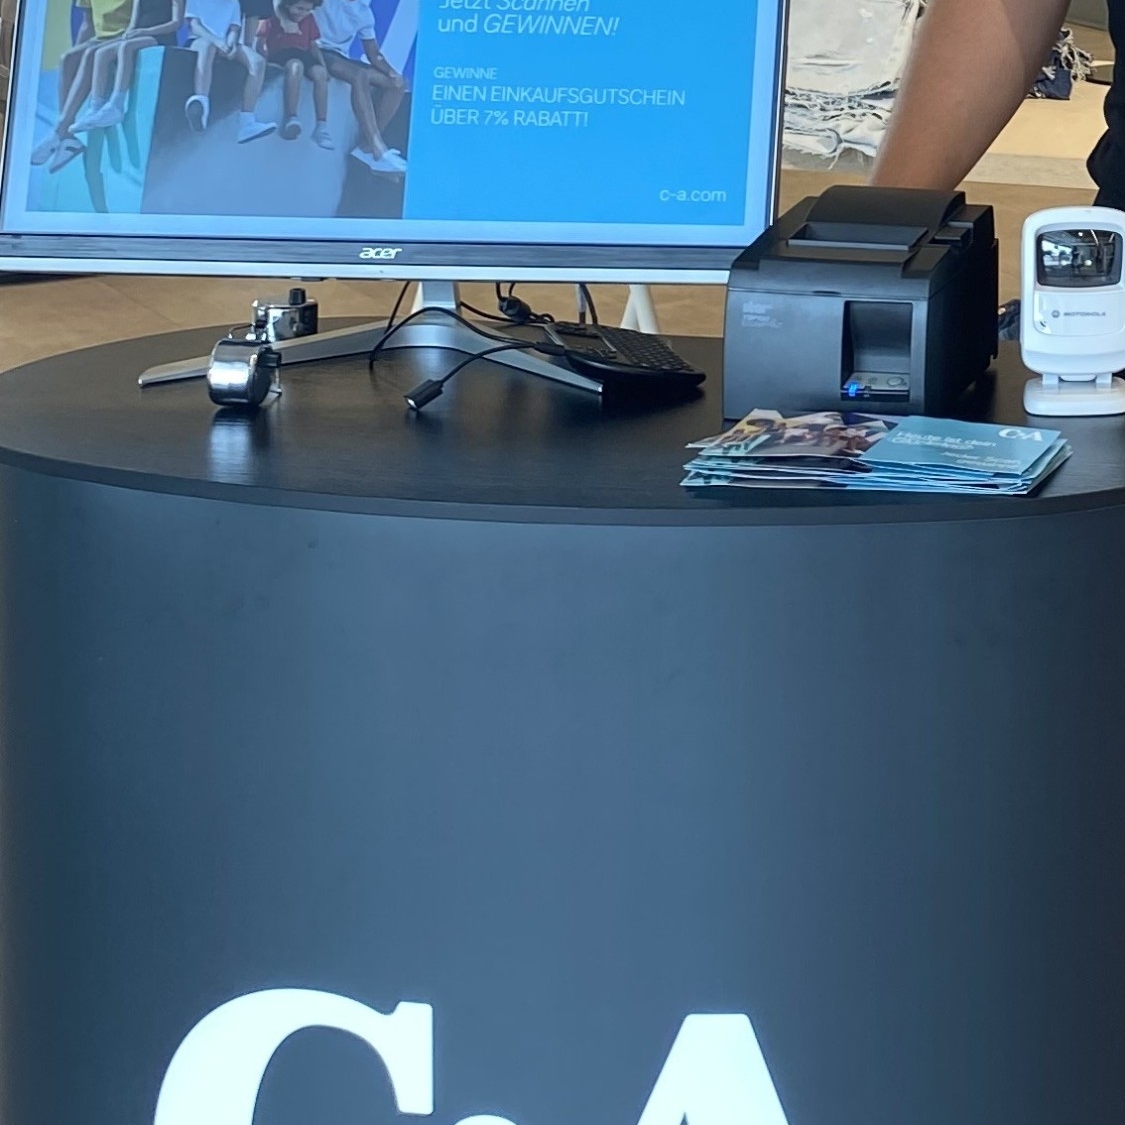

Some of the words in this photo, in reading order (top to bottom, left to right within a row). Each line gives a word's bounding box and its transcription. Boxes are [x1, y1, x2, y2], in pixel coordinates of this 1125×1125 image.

[438, 13, 479, 34] und
[483, 13, 621, 38] GEWINNEN!
[433, 66, 498, 81] GEWINNE
[432, 85, 487, 102] EINEN
[490, 86, 687, 106] EINKAUFSGUTSCHEIN
[430, 104, 480, 126] ÜBER
[483, 109, 510, 126] 7%
[513, 110, 589, 128] RABATT!
[658, 188, 728, 203] c-a.com
[359, 247, 403, 260] acer
